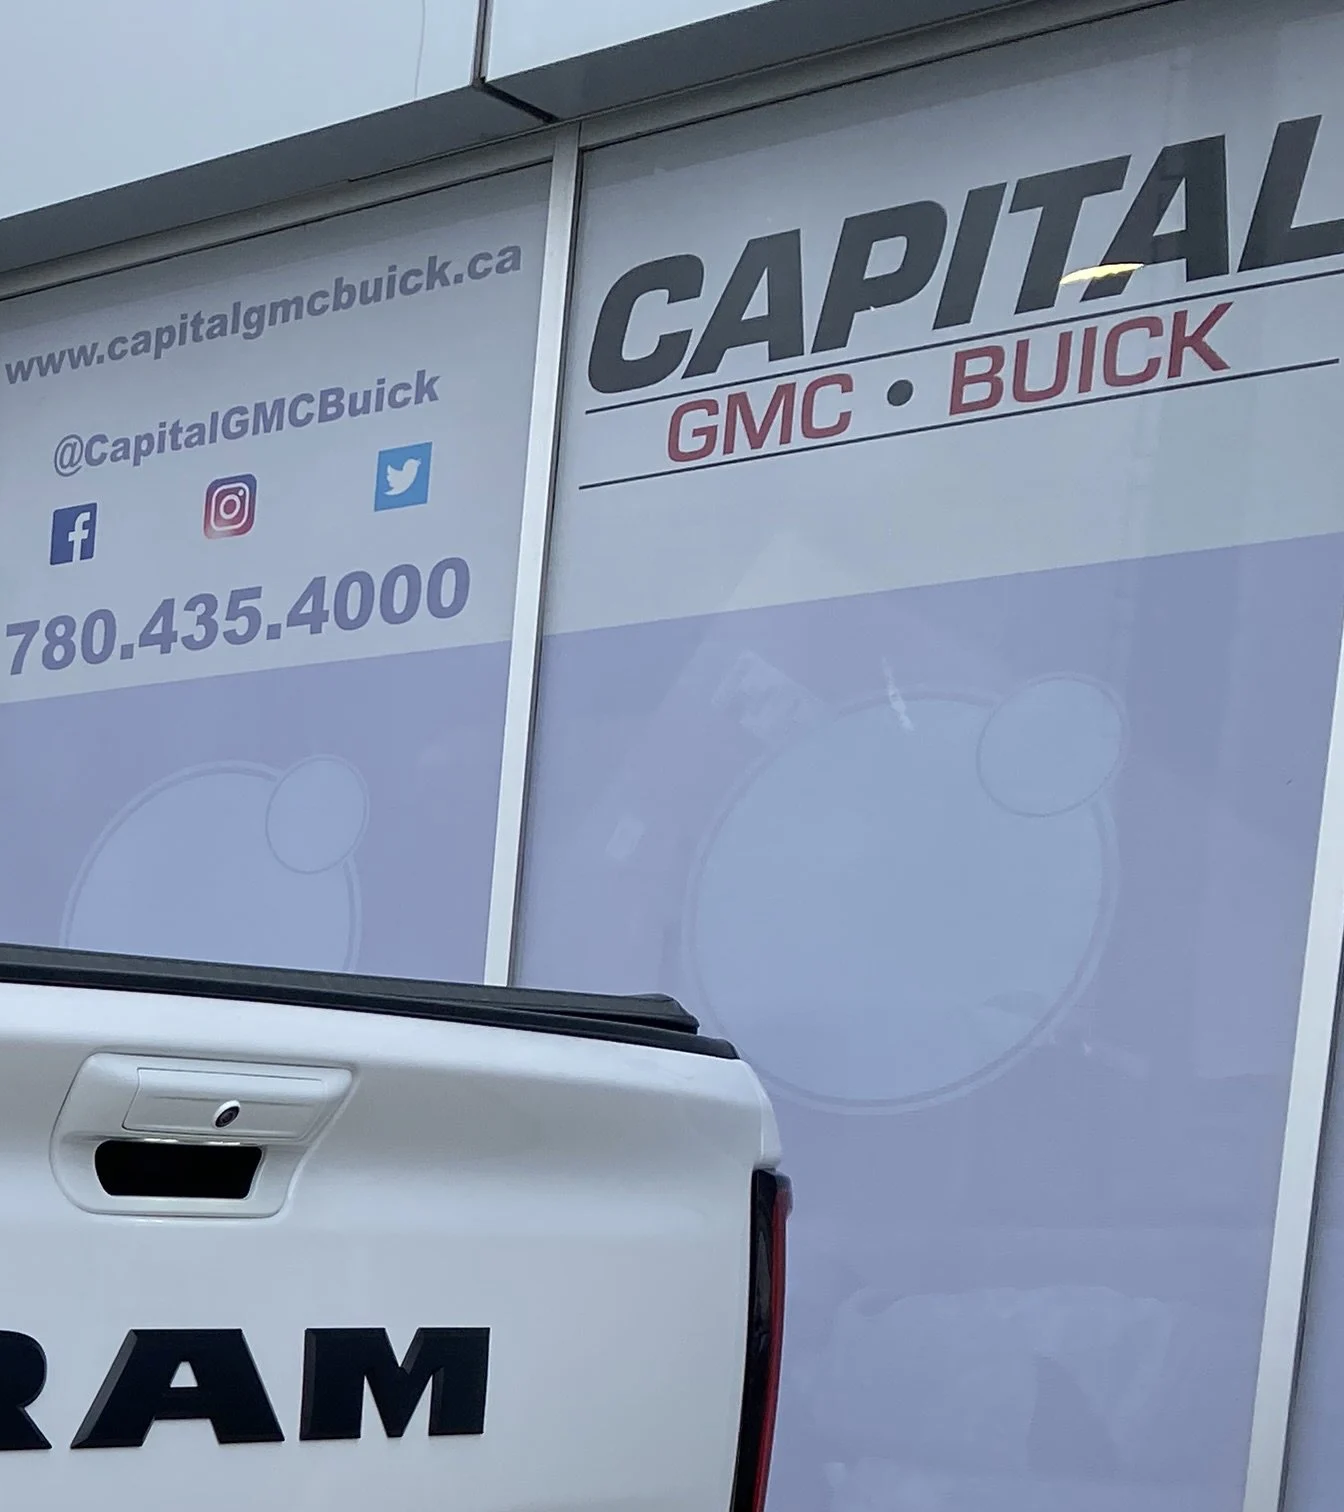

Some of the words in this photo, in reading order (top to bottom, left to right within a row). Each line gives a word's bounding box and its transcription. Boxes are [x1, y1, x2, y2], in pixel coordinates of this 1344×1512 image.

[4, 242, 522, 385] www.capitalgmcbuick.ca
[588, 114, 1344, 394] CAPITAL
[52, 369, 441, 477] @CapitalGMCBuick
[667, 373, 853, 463] GMC
[949, 302, 1234, 416] BUICK
[5, 557, 471, 676] 780.435.4000
